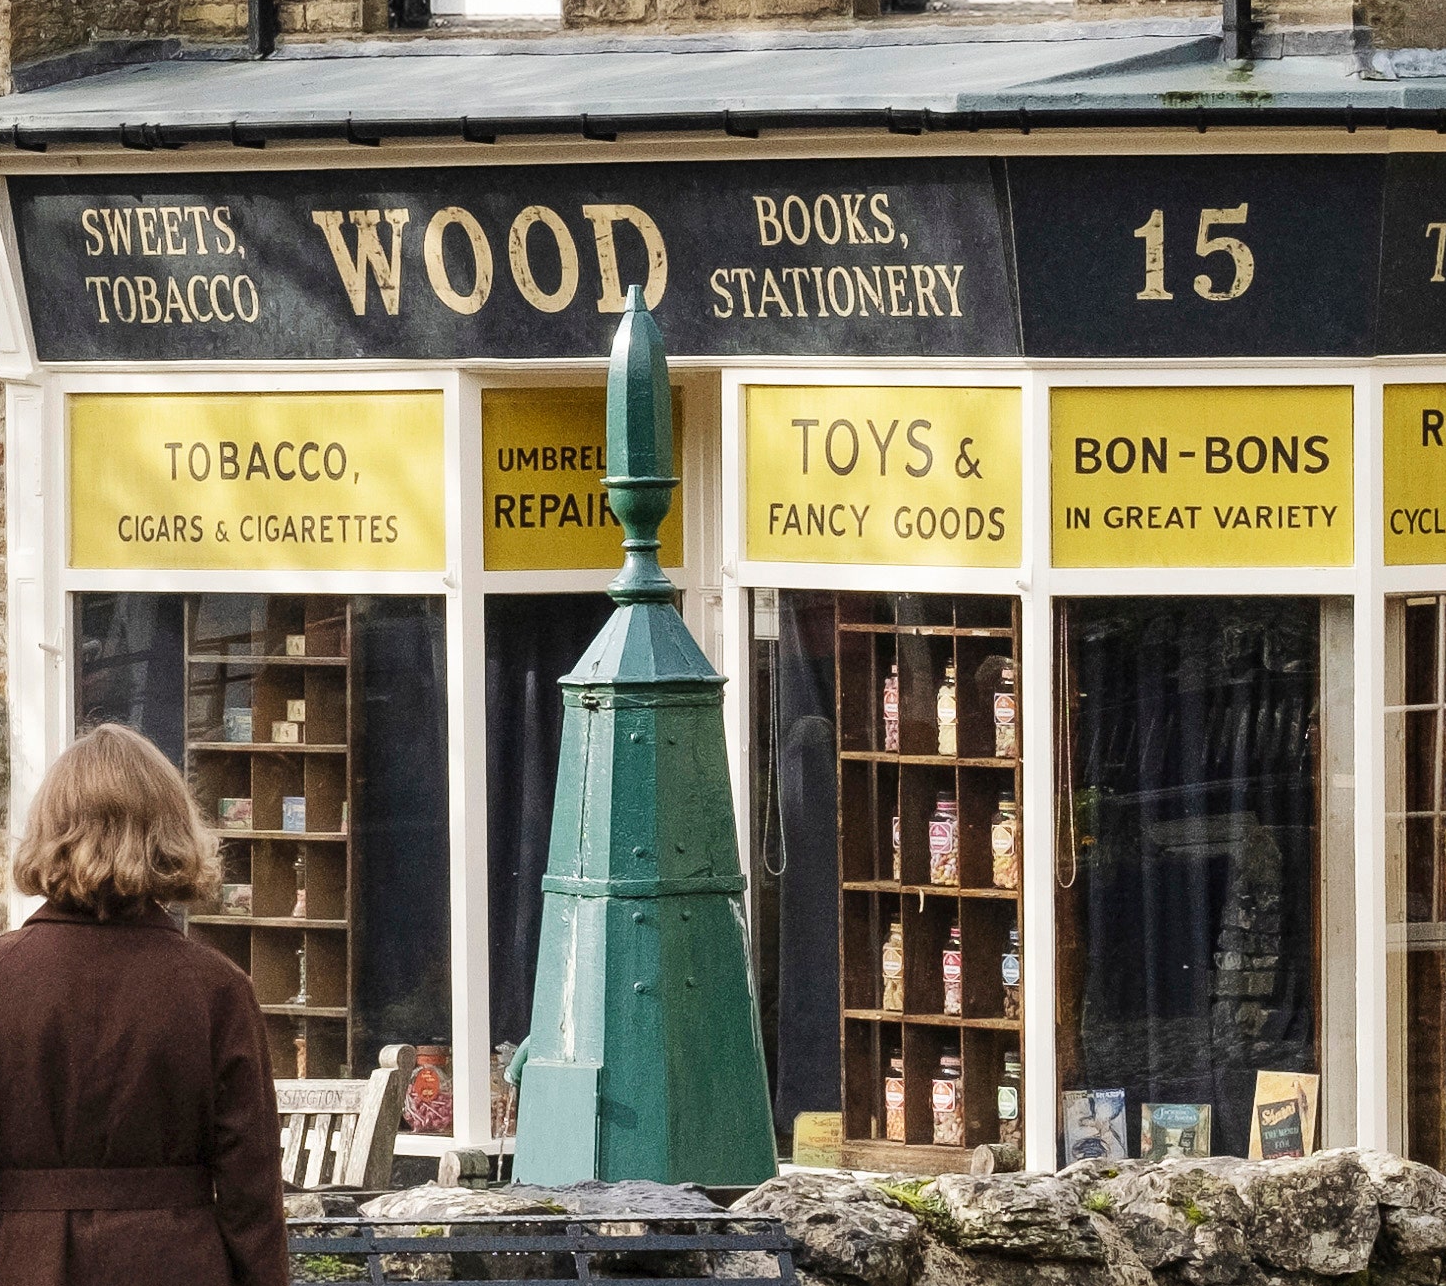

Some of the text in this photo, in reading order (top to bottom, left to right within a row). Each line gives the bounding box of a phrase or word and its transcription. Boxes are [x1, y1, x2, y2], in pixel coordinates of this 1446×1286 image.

[81, 205, 246, 259] SWEETS,
[752, 193, 909, 249] BOOKS,
[311, 204, 668, 316] WOOD
[1133, 202, 1255, 302] 15
[85, 274, 260, 324] TOBACCO
[709, 264, 964, 318] STATIONERY
[164, 441, 360, 484] TOBACCO,
[497, 445, 607, 472] UMBREL
[791, 418, 984, 479] TOYS &
[1074, 435, 1330, 474] BON-BONS
[118, 514, 399, 544] CIGARS & CIGARETTES
[494, 492, 621, 529] REPAIR
[768, 503, 1006, 542] FANCY GOODS
[1065, 505, 1338, 529] IN GREAT VARIETY
[276, 1089, 345, 1106] SSINGTON
